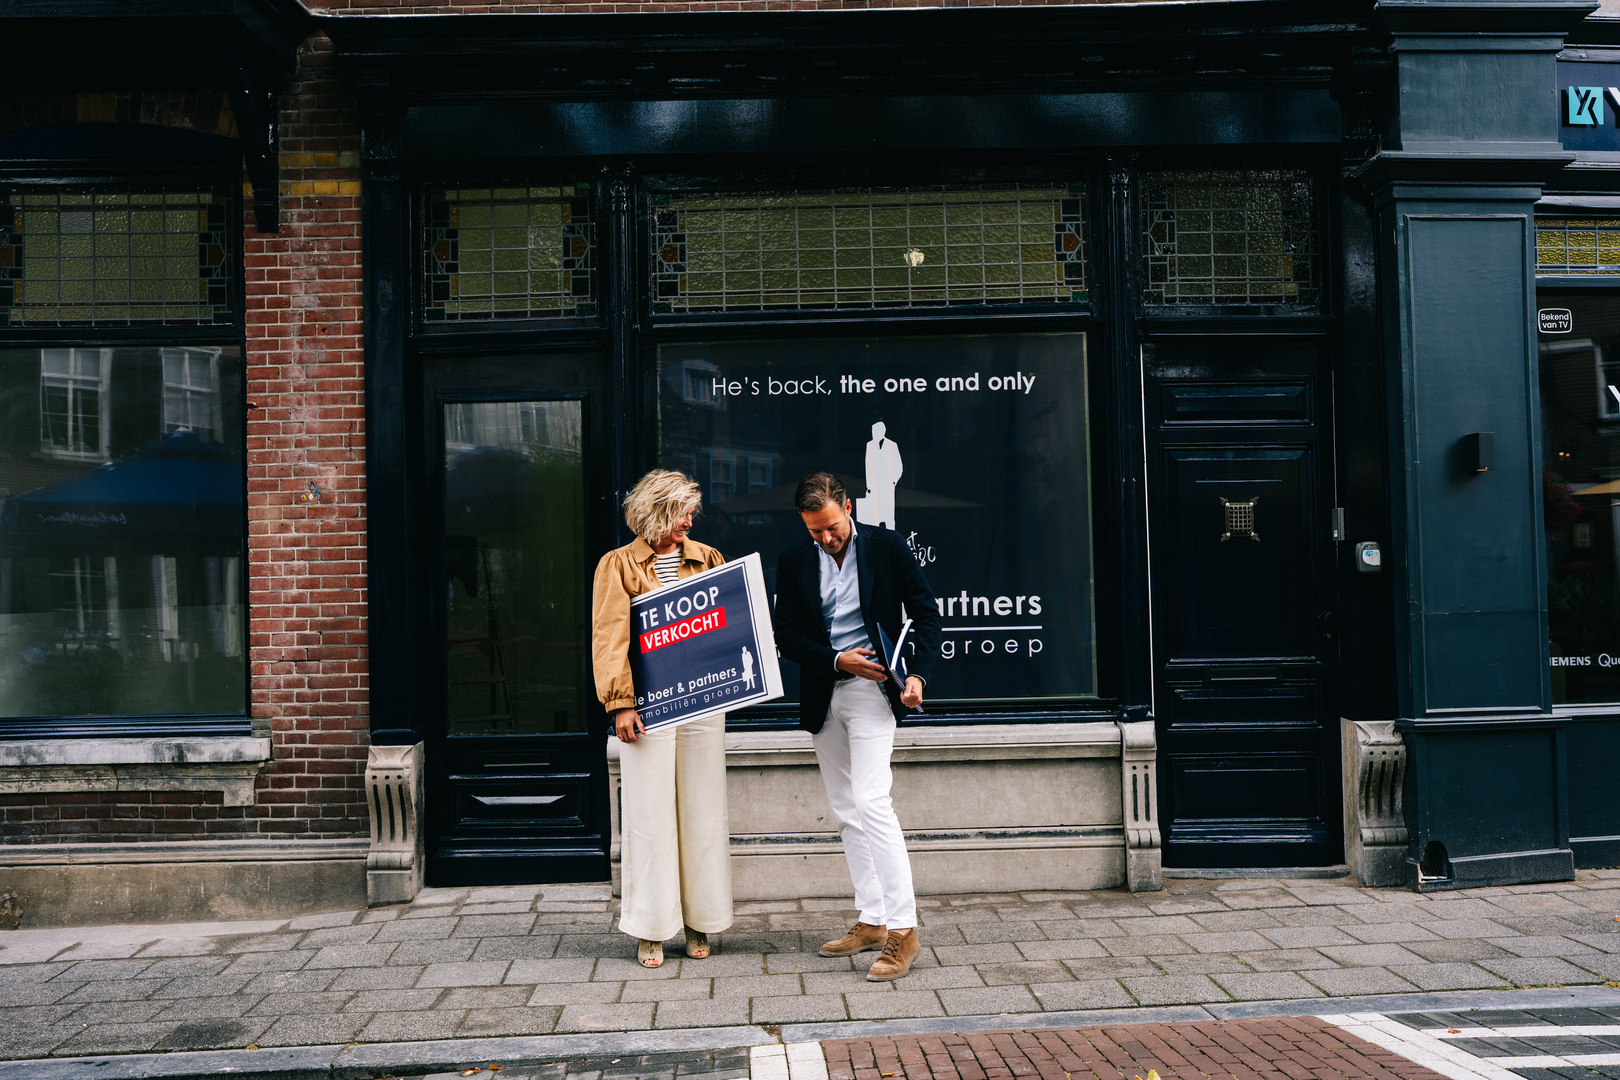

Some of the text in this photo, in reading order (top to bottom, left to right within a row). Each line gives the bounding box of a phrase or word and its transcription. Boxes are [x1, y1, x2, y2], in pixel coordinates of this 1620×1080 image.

[1540, 313, 1569, 321] Bekend
[1558, 321, 1569, 329] TV
[711, 371, 1036, 396] He’s back, the one and only
[639, 586, 719, 630] TE KOOP
[643, 611, 720, 650] VERKOCHT
[941, 638, 1043, 660] groep
[1549, 656, 1592, 667] IEMENS
[647, 686, 674, 703] boer
[677, 682, 686, 694] &
[688, 667, 737, 692] partners
[703, 684, 740, 702] groep
